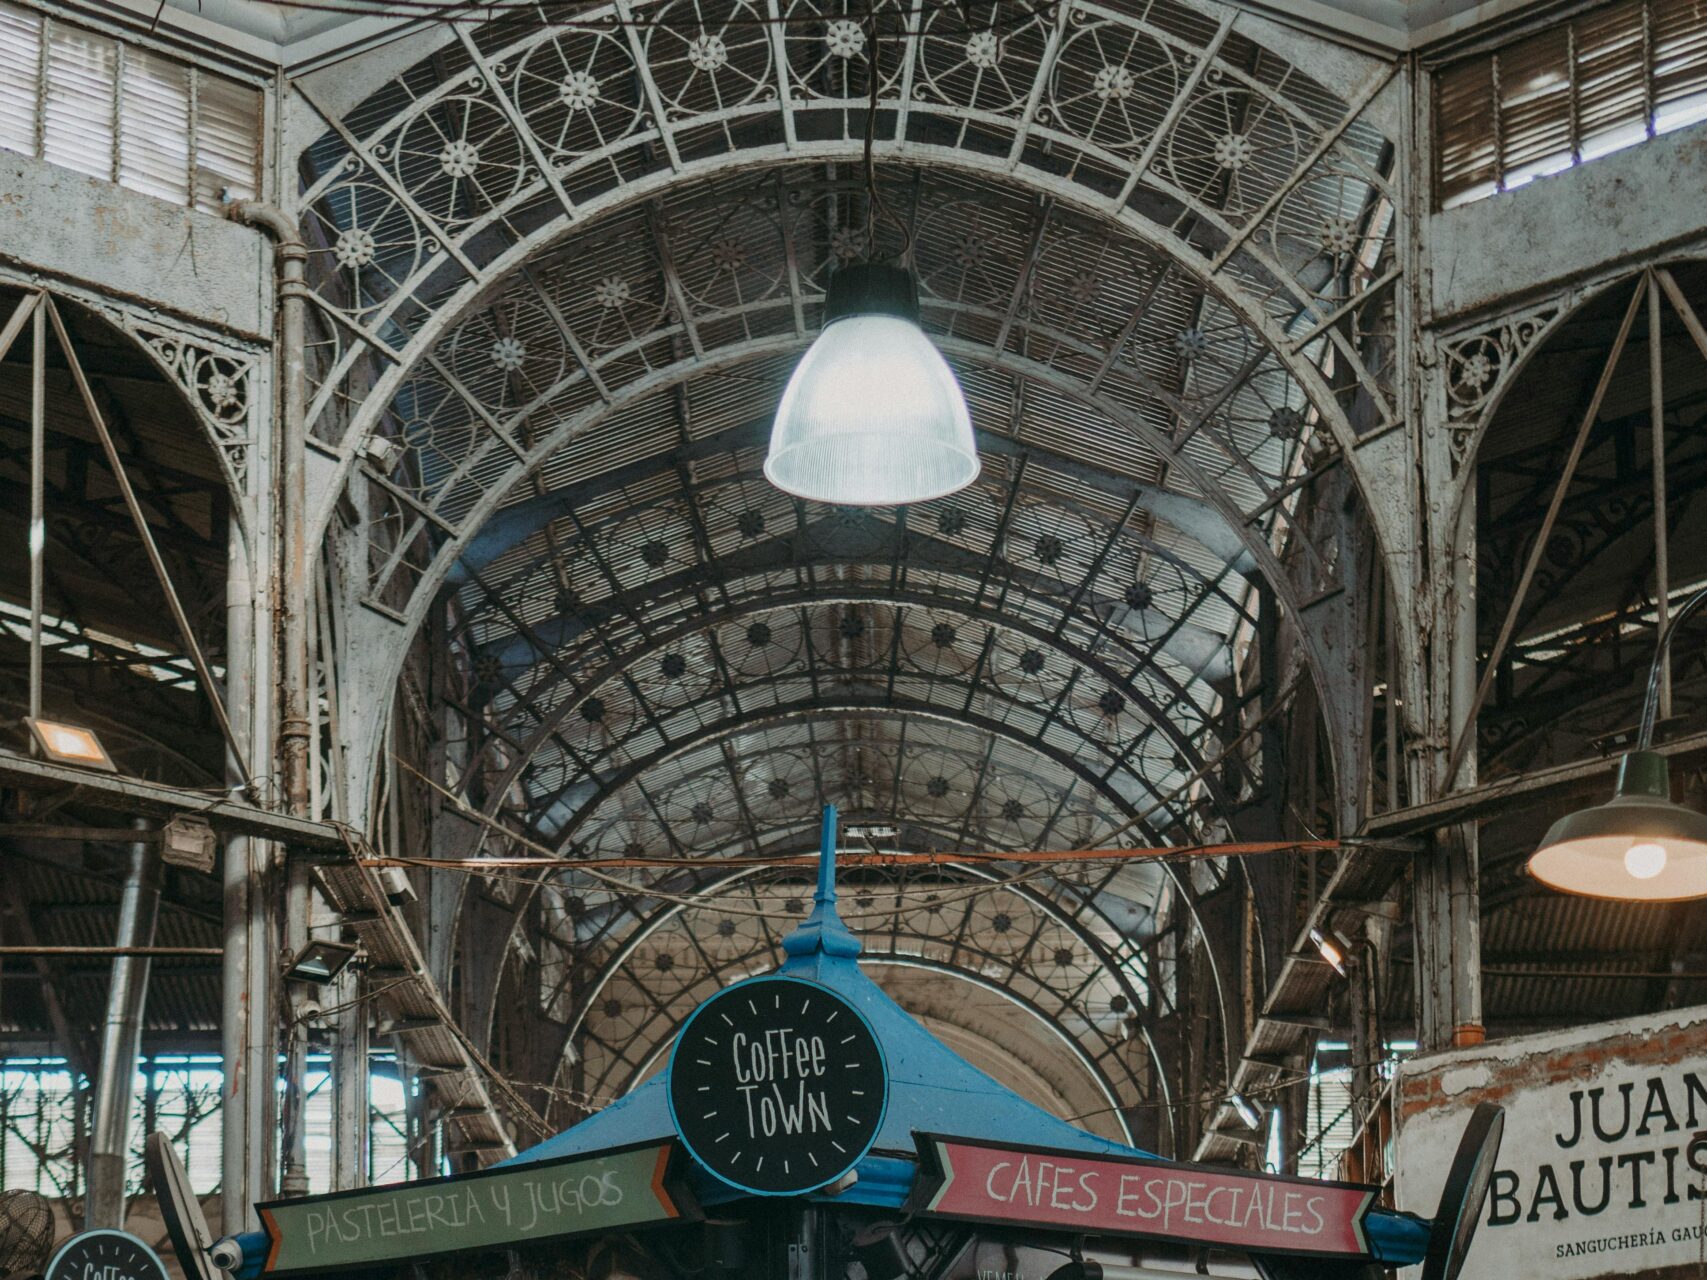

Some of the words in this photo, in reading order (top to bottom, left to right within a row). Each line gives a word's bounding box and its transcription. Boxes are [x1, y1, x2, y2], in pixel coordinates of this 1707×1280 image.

[306, 1185, 486, 1254] PASTELERIA
[520, 1171, 624, 1231] JUGOS
[986, 1155, 1100, 1212] CAFES
[1116, 1175, 1326, 1235] ESPECIALES
[1556, 1227, 1666, 1258] SANGUCHERÍA
